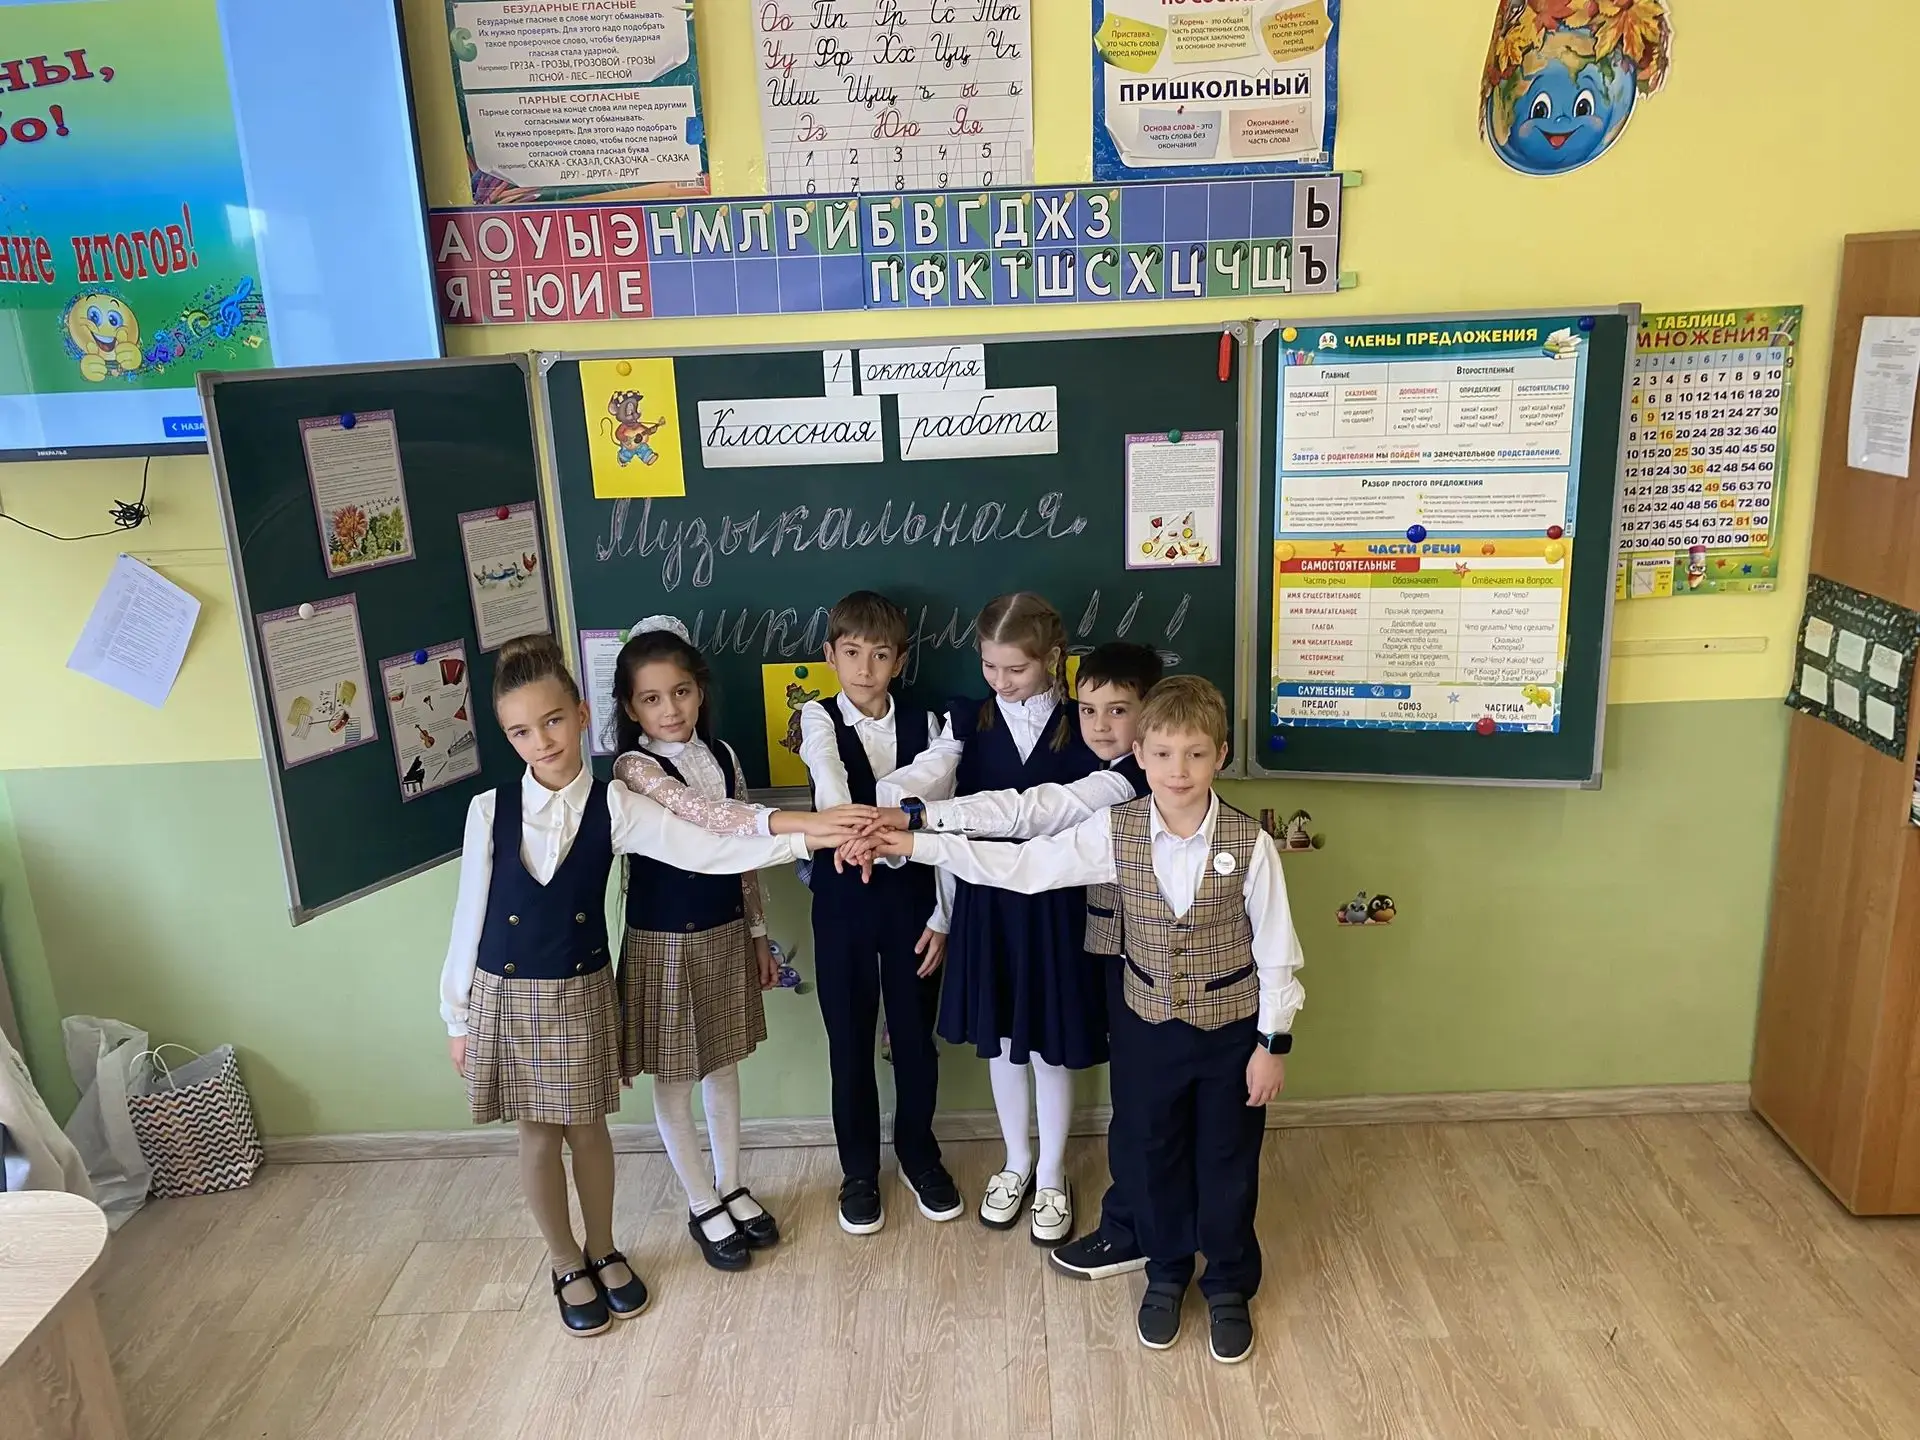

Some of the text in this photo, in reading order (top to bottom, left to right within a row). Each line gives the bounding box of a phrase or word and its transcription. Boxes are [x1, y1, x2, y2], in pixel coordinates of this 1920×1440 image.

[503, 1, 637, 14] БЕЗУДАРНЫЕ ГЛАСНЫЕ
[477, 17, 524, 27] Безударные
[526, 15, 558, 24] гласные
[565, 14, 589, 22] слове
[590, 13, 613, 22] могут
[614, 12, 665, 21] обманывать.
[761, 3, 793, 32] Оо
[810, 0, 847, 29] Пп
[875, 0, 907, 35] Рр
[1179, 18, 1205, 26] Корень
[1274, 13, 1304, 22] Суффикс
[1111, 31, 1151, 39] Приставка
[763, 29, 1021, 78] Уу Фф Хх Цц Чч
[541, 60, 573, 70] ГРОЗЫ,
[573, 56, 620, 68] ГРОЗОВОЙ
[626, 56, 656, 65] ГРОЗЫ
[571, 72, 588, 80] ЛЕС
[596, 69, 632, 80] ЛЕСНОЙ
[767, 78, 820, 106] Шш
[844, 75, 898, 109] Щщ
[1120, 73, 1310, 101] ПРИШКОЛЬНЫЙ
[519, 92, 640, 105] ПАРНЫЕ СОГЛАСНЫЕ
[797, 106, 983, 142] Ээ Юю Яя
[1173, 123, 1195, 131] слова
[1247, 119, 1290, 127] Окончание
[604, 156, 649, 166] СКАЗОЧКА
[656, 153, 690, 163] СКАЗКА
[586, 168, 640, 178] ДРУГА ДРУГ
[438, 186, 1331, 264] А О У Ы Э Н М Л Р Й Б В Г Д Ж З Ь
[71, 200, 199, 284] итогов!
[445, 245, 1327, 319] Я Ё Ю И Е П Ф К Т Ш С Х Ц Ч Щ Ъ
[1656, 313, 1736, 330] ТАБЛИЦА
[1344, 328, 1538, 347] ЧЛЕНЫ ПРЕДЛОЖЕНИЯ
[832, 346, 981, 391] 1 октября
[1290, 391, 1329, 399] ПОДЛЕЖАЩЕЕ
[1399, 388, 1438, 396] ДОПОЛНЕНИЕ
[1459, 385, 1501, 393] ОПРЕДЕЛЕНИЕ
[1517, 384, 1570, 392] ОБСТОЯТЕЛЬСТВО
[705, 395, 1053, 456] Классная работа
[1292, 453, 1319, 462] Завтра
[1327, 453, 1374, 462] родителями
[1497, 448, 1562, 457] представление.
[1620, 533, 1768, 549] 20 30 40 50 60 70 80 90 100
[1368, 544, 1461, 554] ЧАСТИ РЕЧИ
[1301, 560, 1396, 571] САМОСТОЯТЕЛЬНЫЕ
[1328, 578, 1346, 587] речи
[1392, 576, 1438, 585] Обозначает
[1472, 576, 1514, 585] Отвечает
[1302, 592, 1362, 600] СУЩЕСТВИТЕЛЬНОЕ
[1298, 685, 1355, 696] СЛУЖЕБНЫЕ
[1302, 700, 1524, 712] ПРЕДЛОГ СОЮЗ ЧАСТИЦА
